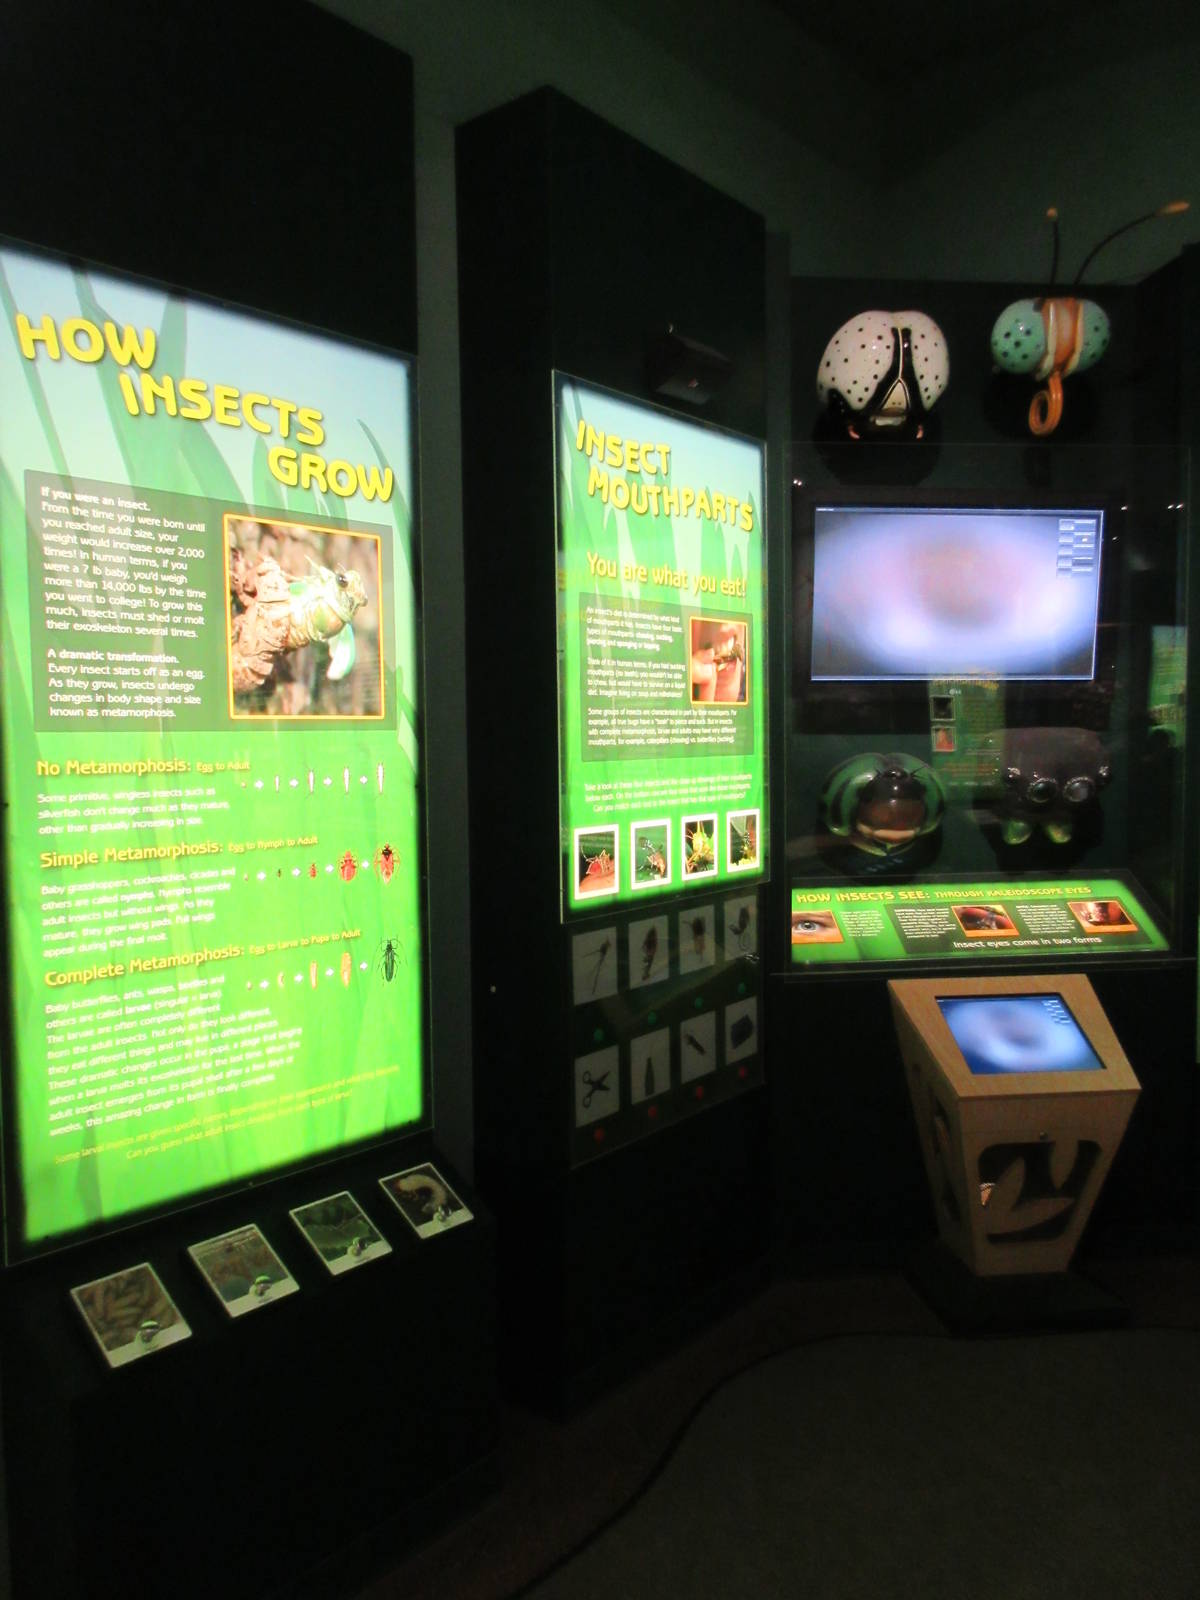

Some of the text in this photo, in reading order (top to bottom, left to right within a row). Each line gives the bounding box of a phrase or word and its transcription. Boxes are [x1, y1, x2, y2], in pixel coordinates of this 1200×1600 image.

[16, 313, 156, 369] HOW
[119, 372, 324, 445] INSECTS
[576, 420, 670, 475] INSECT
[268, 446, 393, 500] GROW
[41, 486, 49, 496] If
[52, 490, 71, 500] you
[74, 493, 99, 503] were
[102, 497, 114, 505] an
[587, 465, 753, 531] MOUTHPARTS
[42, 502, 205, 532] From the time you were born until
[42, 519, 62, 529] you
[65, 522, 105, 533] reached
[108, 526, 132, 536] adult
[158, 533, 178, 543] your
[43, 533, 204, 558] weight would increase over 2,000
[43, 546, 76, 559] times!
[92, 552, 126, 564] human
[171, 562, 188, 572] you
[44, 564, 70, 572] were
[83, 565, 89, 574] 7
[133, 571, 158, 582] you'd
[160, 573, 188, 585] weigh
[587, 552, 746, 596] You are what you eat!
[45, 578, 206, 598] more than 14,000 lbs by the time
[45, 592, 203, 612] you went to college! To grow this
[45, 607, 78, 618] much,
[120, 612, 145, 621] must
[147, 612, 169, 622] shed
[184, 615, 204, 625] molt
[47, 620, 198, 638] their exoskeleton several times.
[48, 649, 179, 664] A dramatic transformation.
[48, 663, 77, 676] Every
[80, 664, 110, 675] insect
[113, 666, 140, 676] starts
[143, 667, 156, 677] off
[172, 670, 183, 678] an
[186, 671, 205, 681] egg.
[48, 678, 63, 687] As
[66, 678, 89, 691] they
[92, 681, 118, 691] grow,
[157, 682, 195, 694] undergo
[49, 693, 201, 706] changes in body shape and size
[50, 707, 83, 717] known
[101, 708, 176, 720] metamorphosis.
[37, 763, 60, 775] No
[66, 761, 191, 775] Metamorphosis:
[196, 763, 213, 772] Egg
[228, 762, 249, 770] Adult
[41, 836, 317, 867] Simple Metamorphosis: Egg to Nymph to Adult
[797, 887, 1091, 903] HOW INSECTS SEE: THROUGH KALEIDOSCOPE EYES
[953, 940, 984, 949] Insect
[987, 940, 1010, 949] eyes
[45, 964, 124, 985] Complete
[130, 946, 244, 973] Metamorphosis:
[249, 946, 265, 955] Egg
[301, 938, 308, 946] to
[342, 929, 360, 938] Adult
